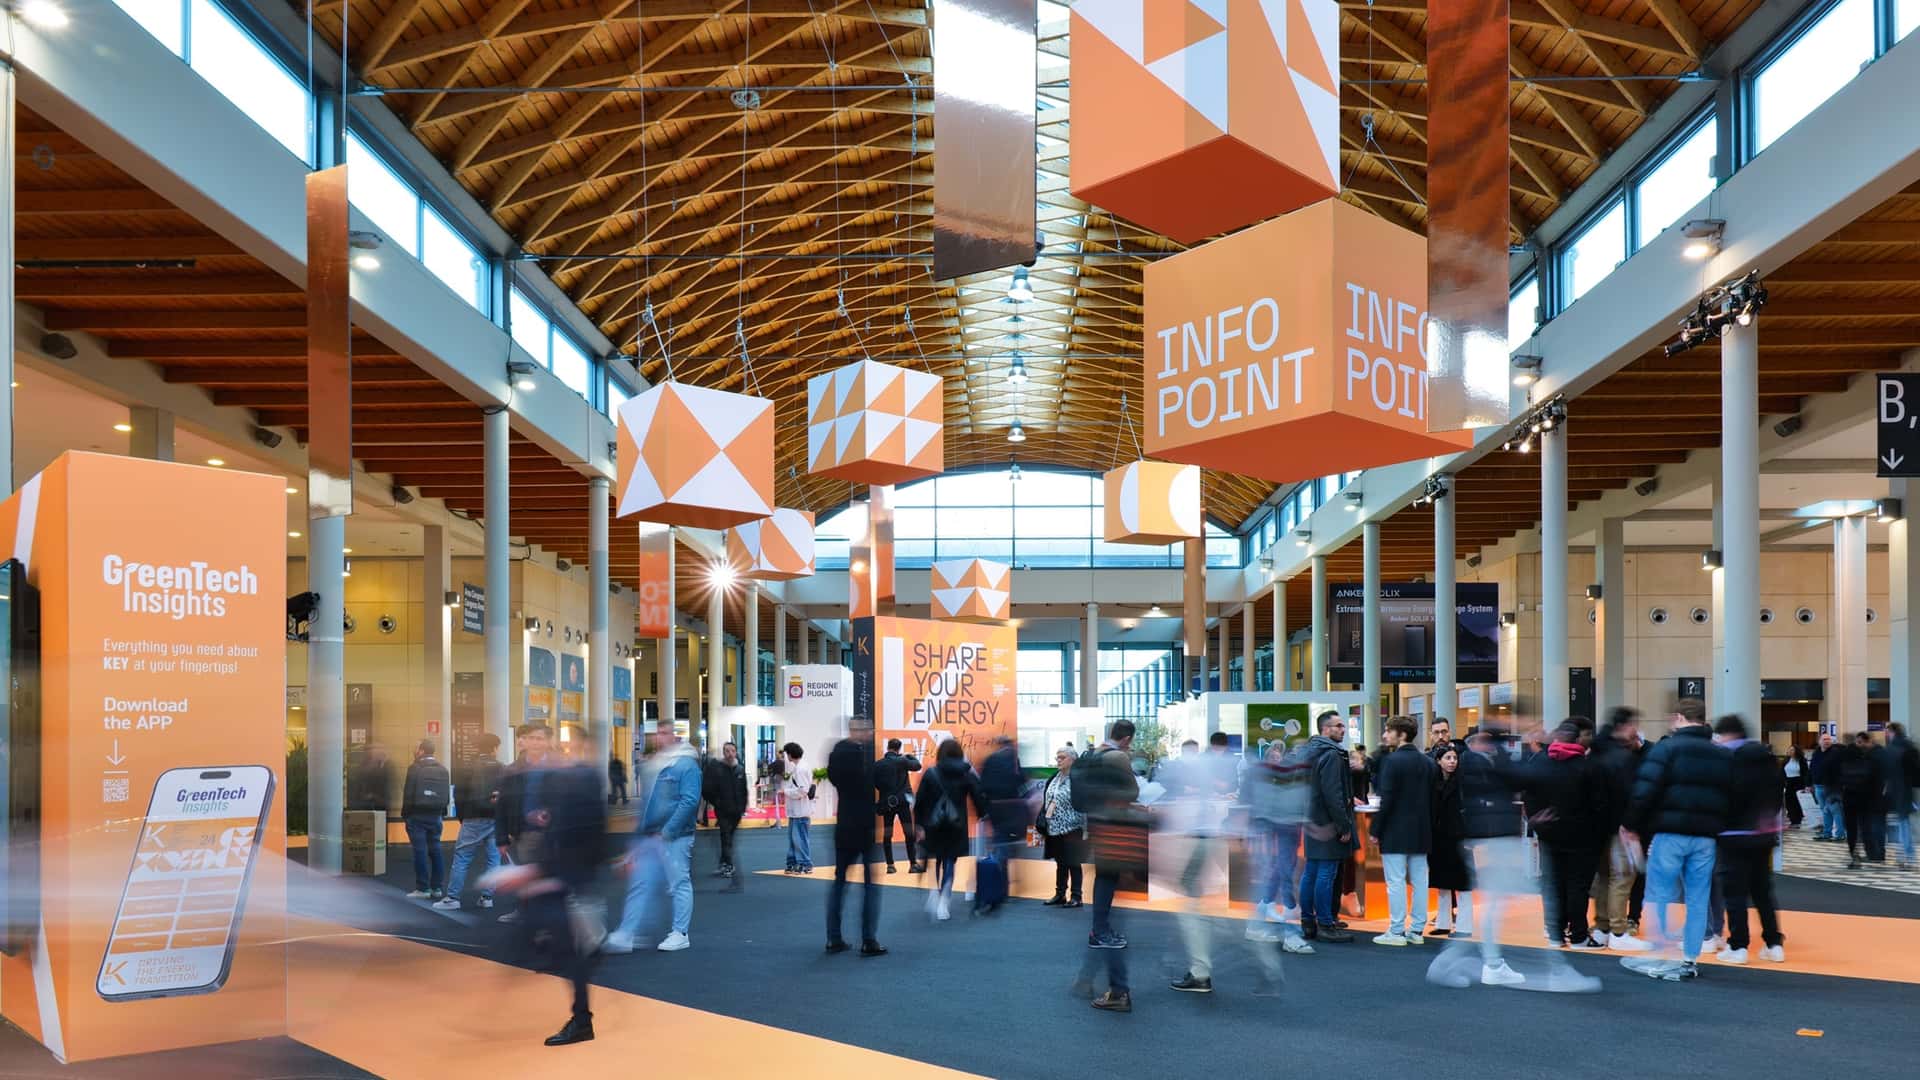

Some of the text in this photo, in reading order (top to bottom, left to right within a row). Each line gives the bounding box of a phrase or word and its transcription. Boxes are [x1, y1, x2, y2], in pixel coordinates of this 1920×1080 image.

[1157, 297, 1280, 379] INFO
[1158, 346, 1314, 437] POINT
[1347, 346, 1427, 420] POI
[103, 554, 257, 595] GreenTech
[124, 588, 226, 620] Insights
[1467, 604, 1493, 614] System
[104, 638, 258, 657] Everything you need about
[913, 643, 987, 671] SHARE
[104, 656, 238, 675] KEY at your fingertips!
[807, 682, 839, 690] REGIONE
[913, 671, 973, 698] YOUR
[104, 697, 188, 712] Download
[913, 698, 999, 725] ENERGY
[104, 715, 173, 730] the APP
[177, 786, 247, 802] GreenTech
[182, 799, 229, 815] Insights
